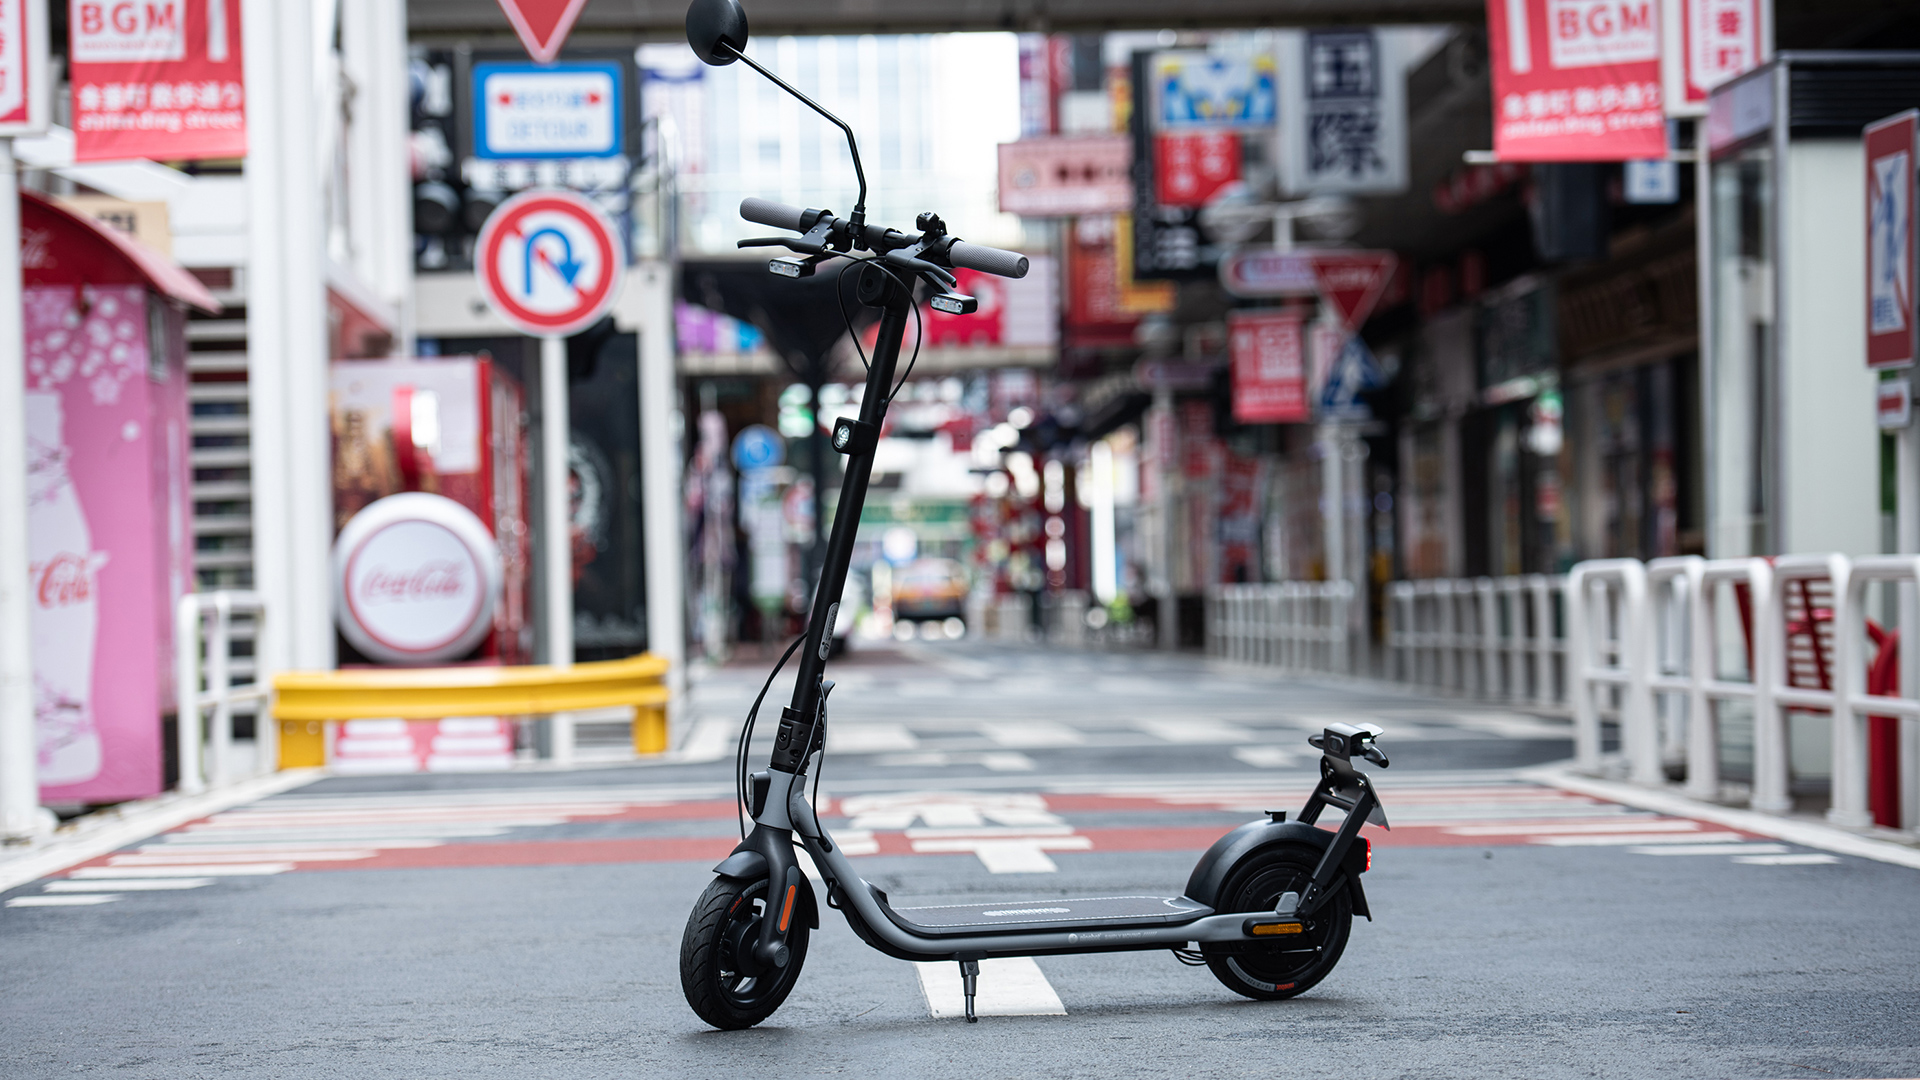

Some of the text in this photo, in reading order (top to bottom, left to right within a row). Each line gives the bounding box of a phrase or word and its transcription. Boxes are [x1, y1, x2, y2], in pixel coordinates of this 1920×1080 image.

[80, 3, 176, 35] BGM
[1558, 4, 1649, 41] BGM
[507, 116, 592, 140] DETOUR
